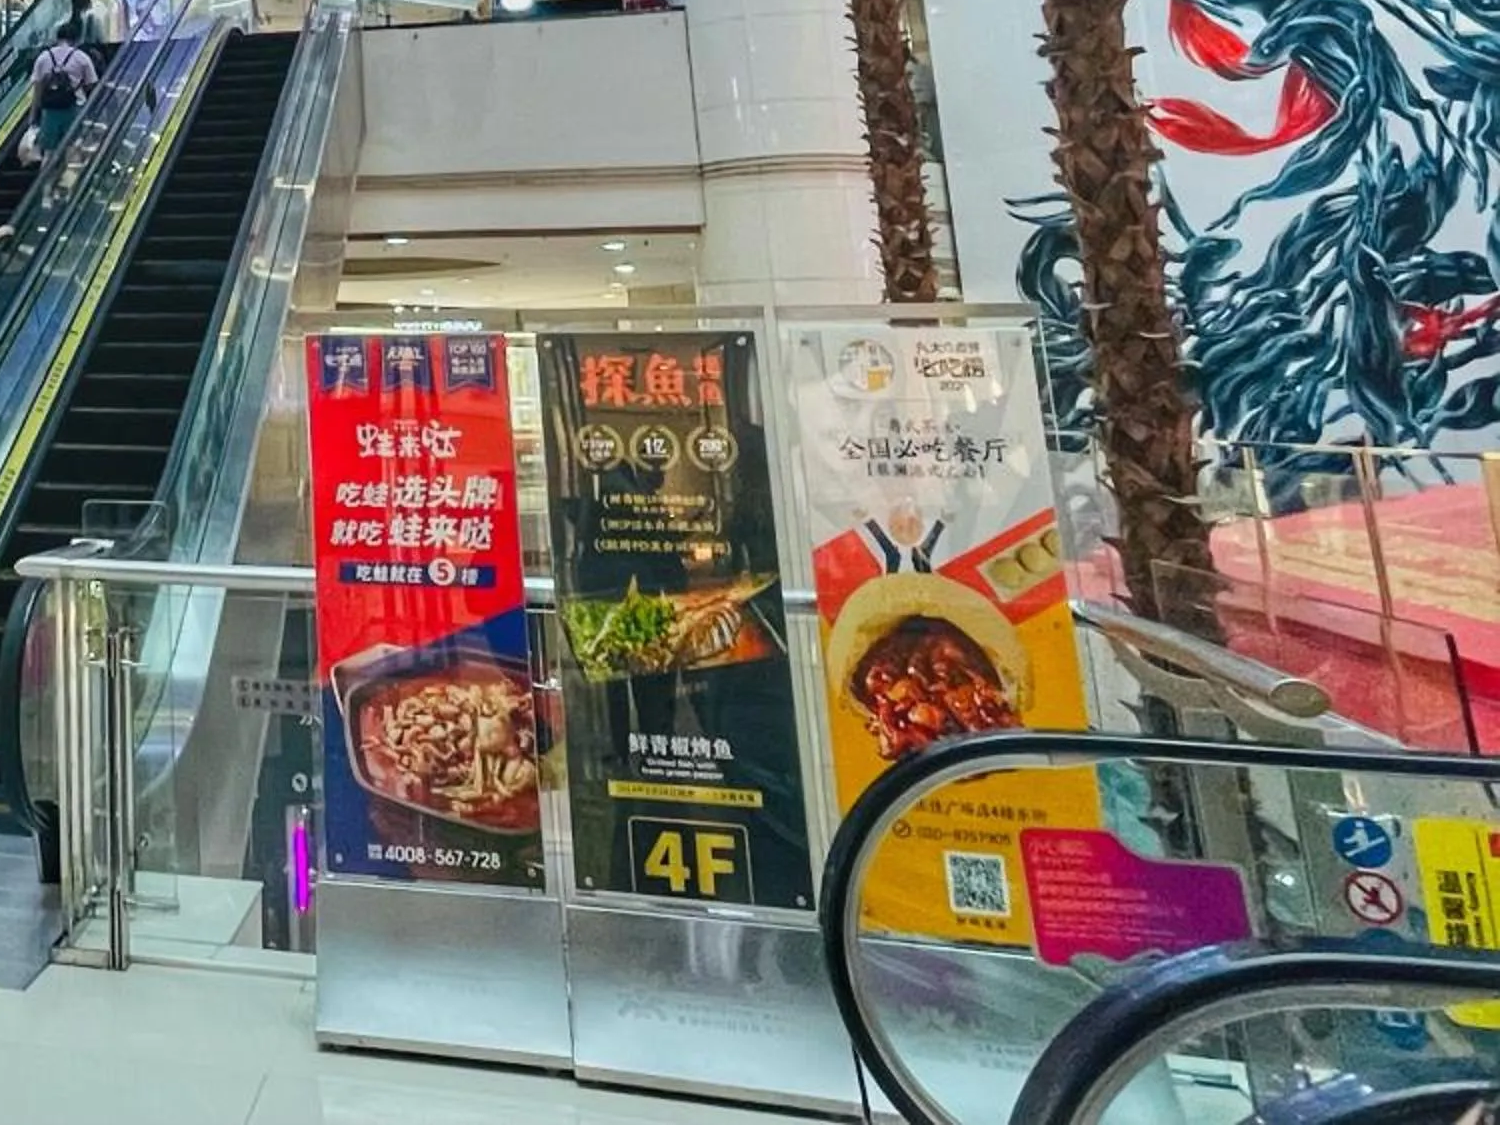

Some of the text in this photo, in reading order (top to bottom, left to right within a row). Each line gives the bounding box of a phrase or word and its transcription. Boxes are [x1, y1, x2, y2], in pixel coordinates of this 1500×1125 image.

[839, 435, 1008, 464] 全国必吃餐厅
[644, 830, 736, 896] 4F
